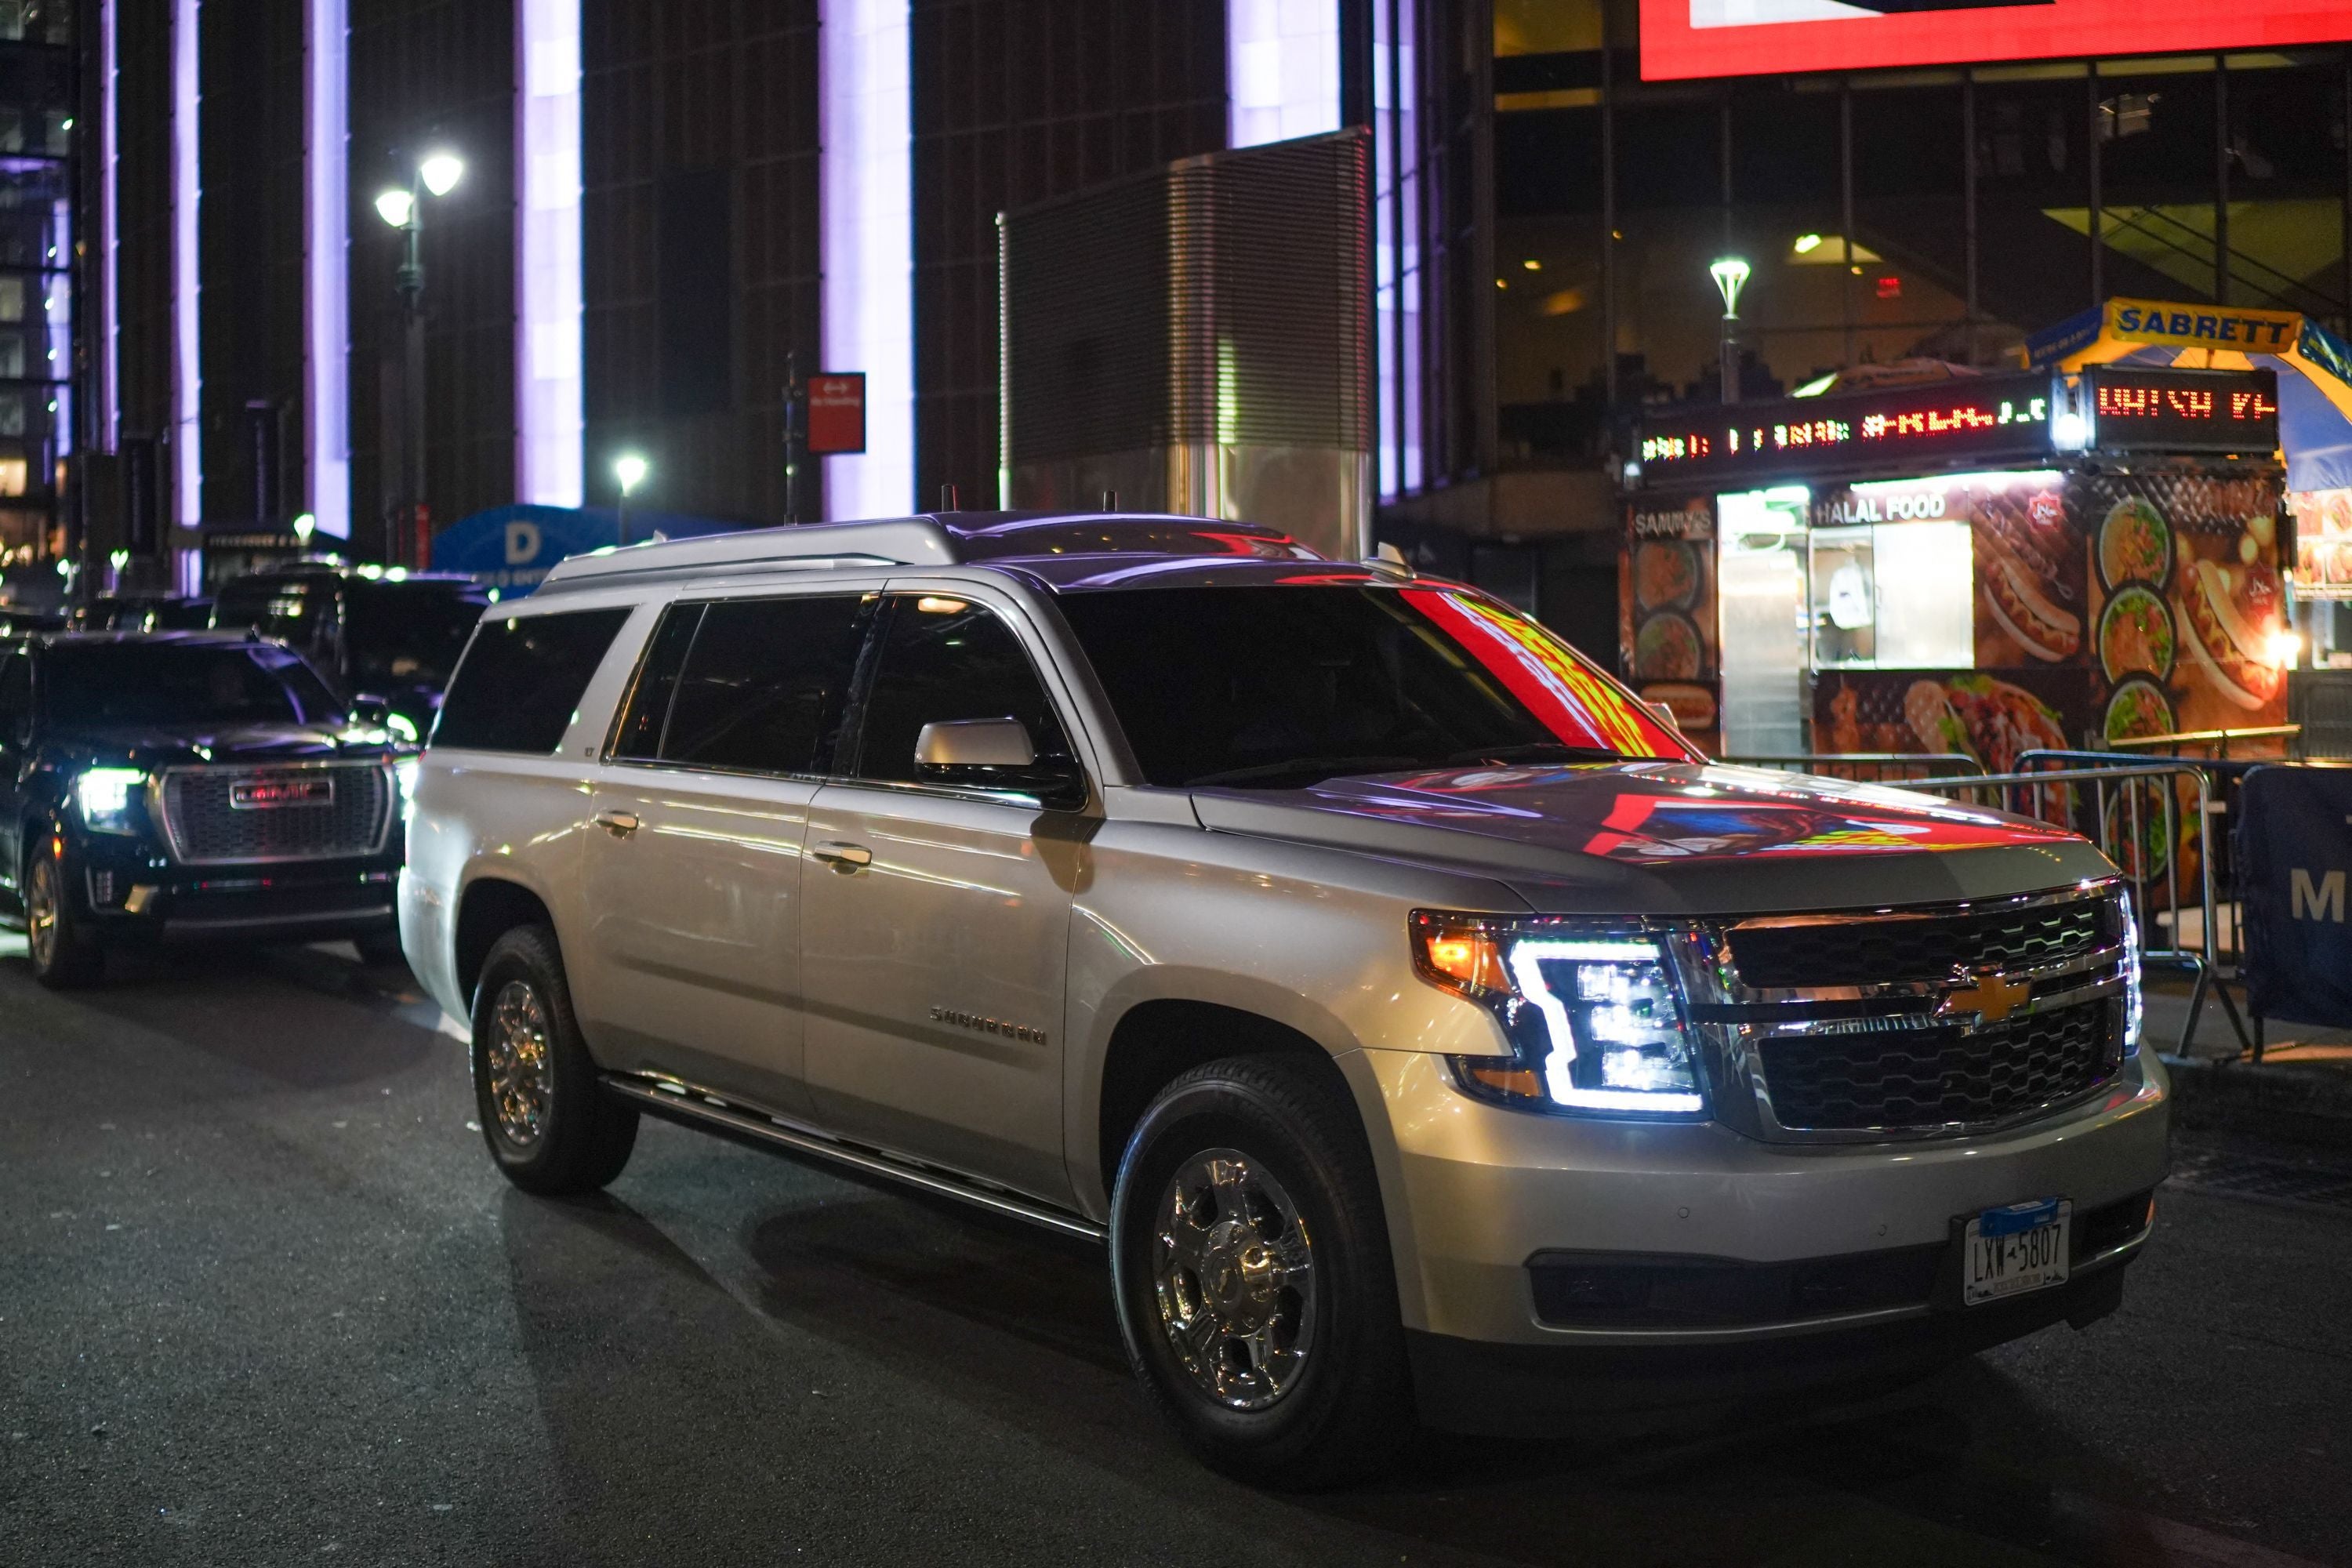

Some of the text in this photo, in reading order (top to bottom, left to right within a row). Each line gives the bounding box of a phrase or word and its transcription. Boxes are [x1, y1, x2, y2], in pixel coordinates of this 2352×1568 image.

[2118, 309, 2290, 344] SABRETT
[1635, 510, 1711, 536] SAMMY'S
[1817, 493, 1946, 524] HALAL FOOD
[505, 521, 541, 564] D
